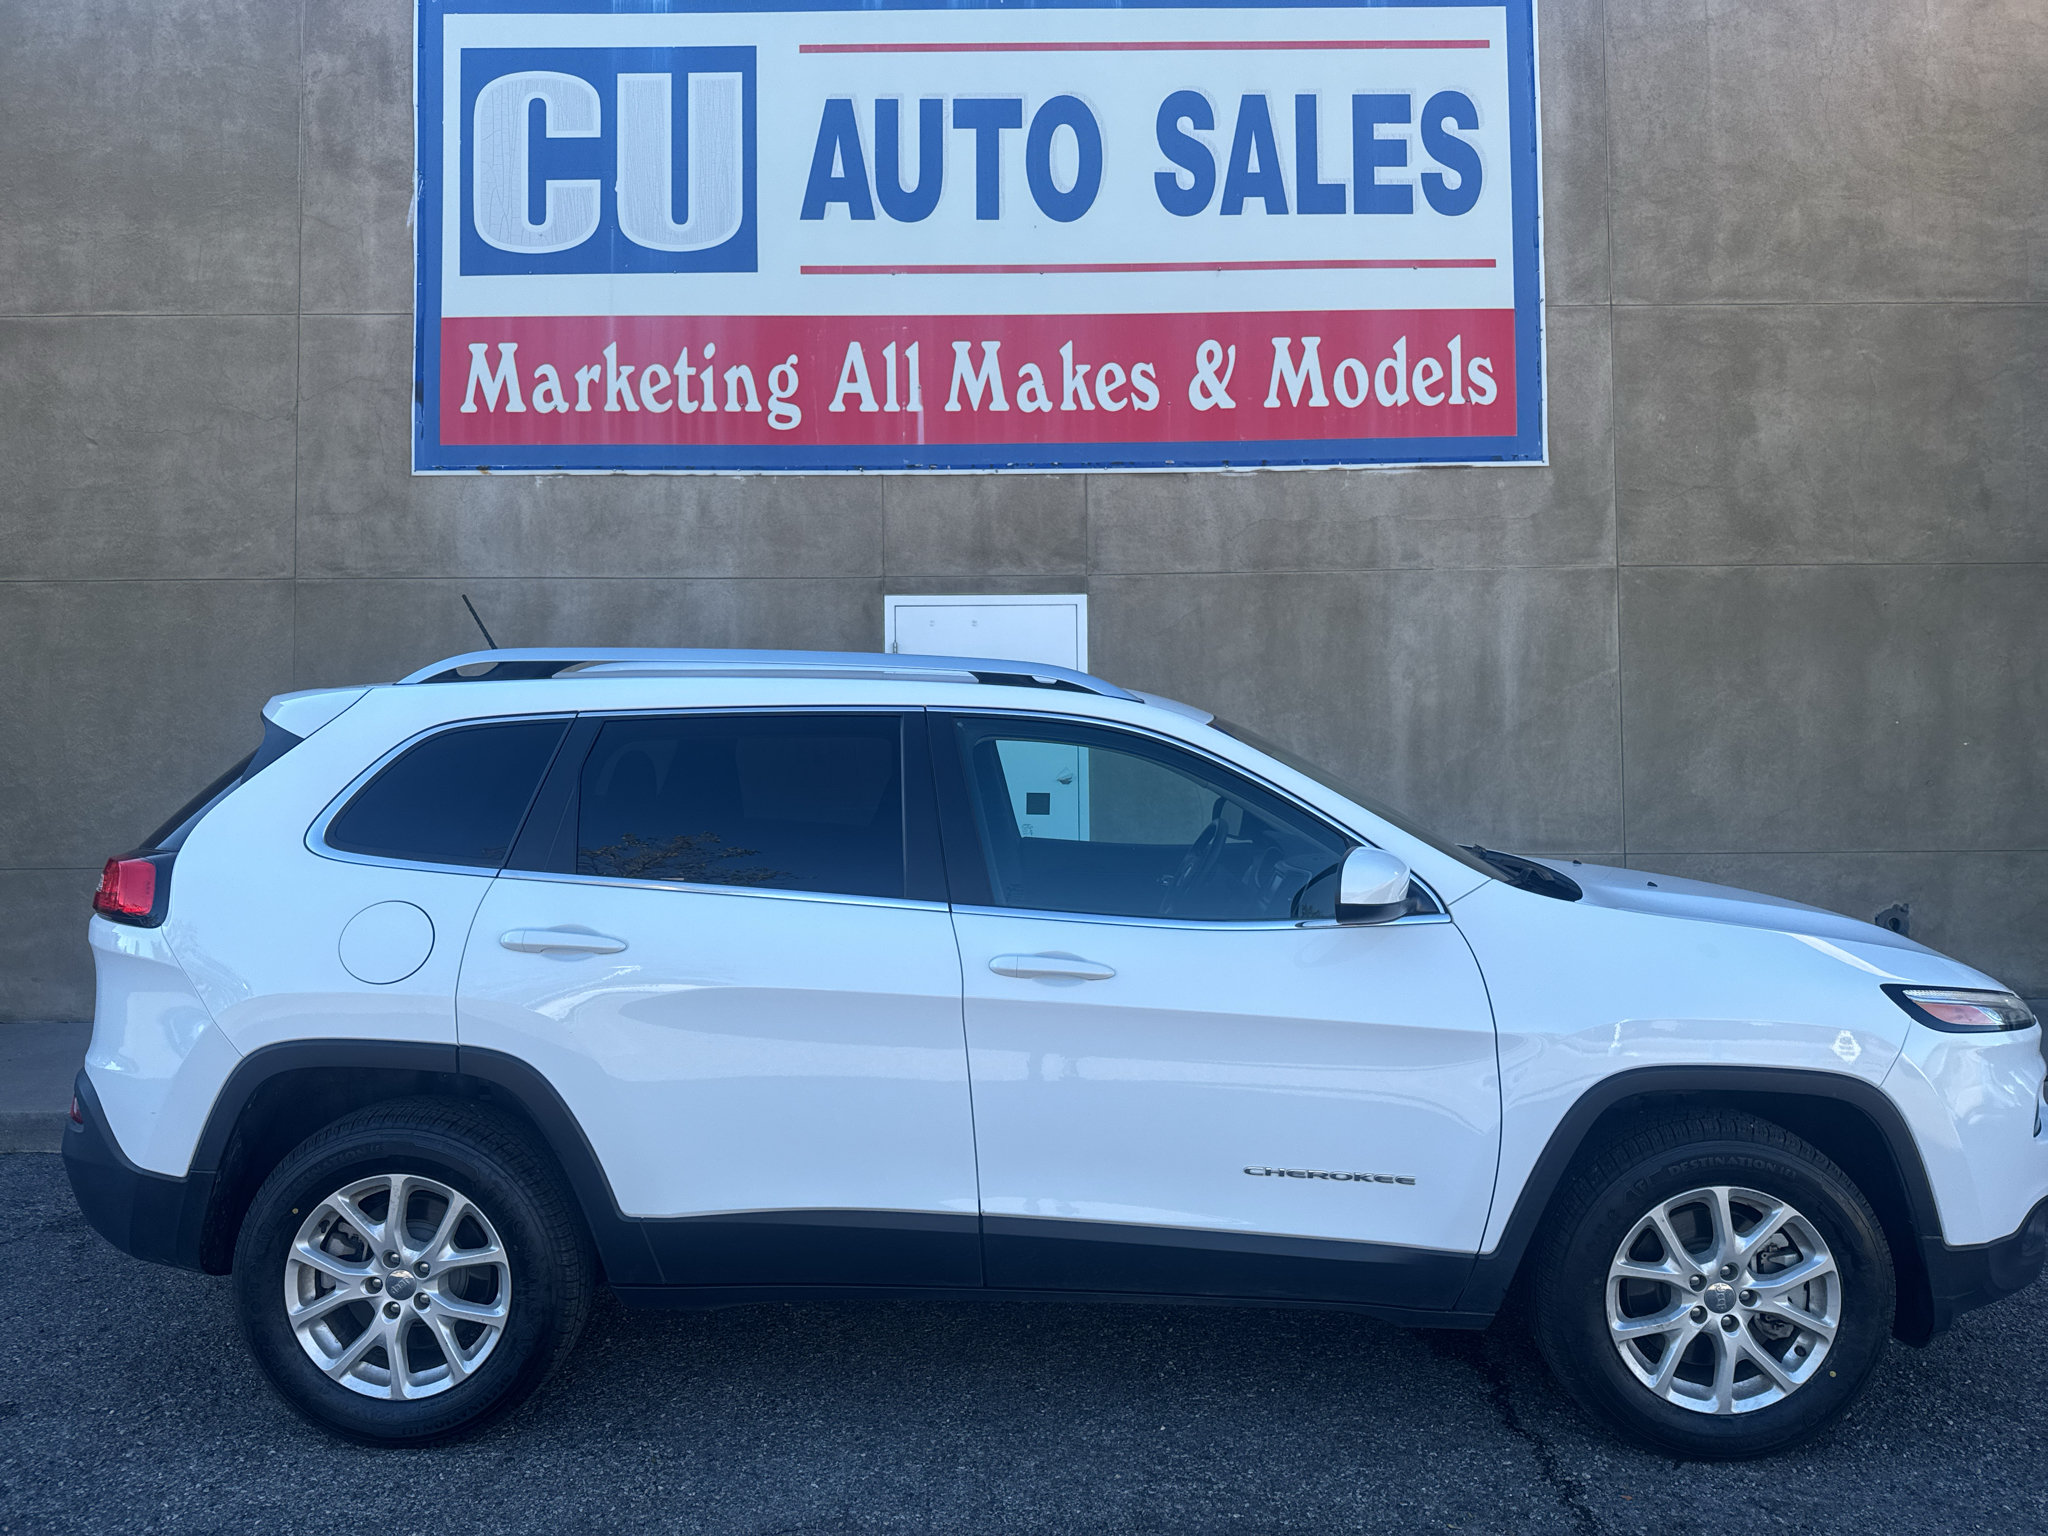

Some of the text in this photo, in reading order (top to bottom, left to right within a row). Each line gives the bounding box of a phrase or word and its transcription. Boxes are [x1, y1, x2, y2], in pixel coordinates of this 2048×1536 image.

[473, 70, 1484, 254] CU AUTO SALES
[460, 333, 1498, 431] Marketing All Makes & Models
[1243, 1165, 1416, 1186] CHEROKEE
[1667, 1156, 1777, 1176] DESTINATION
